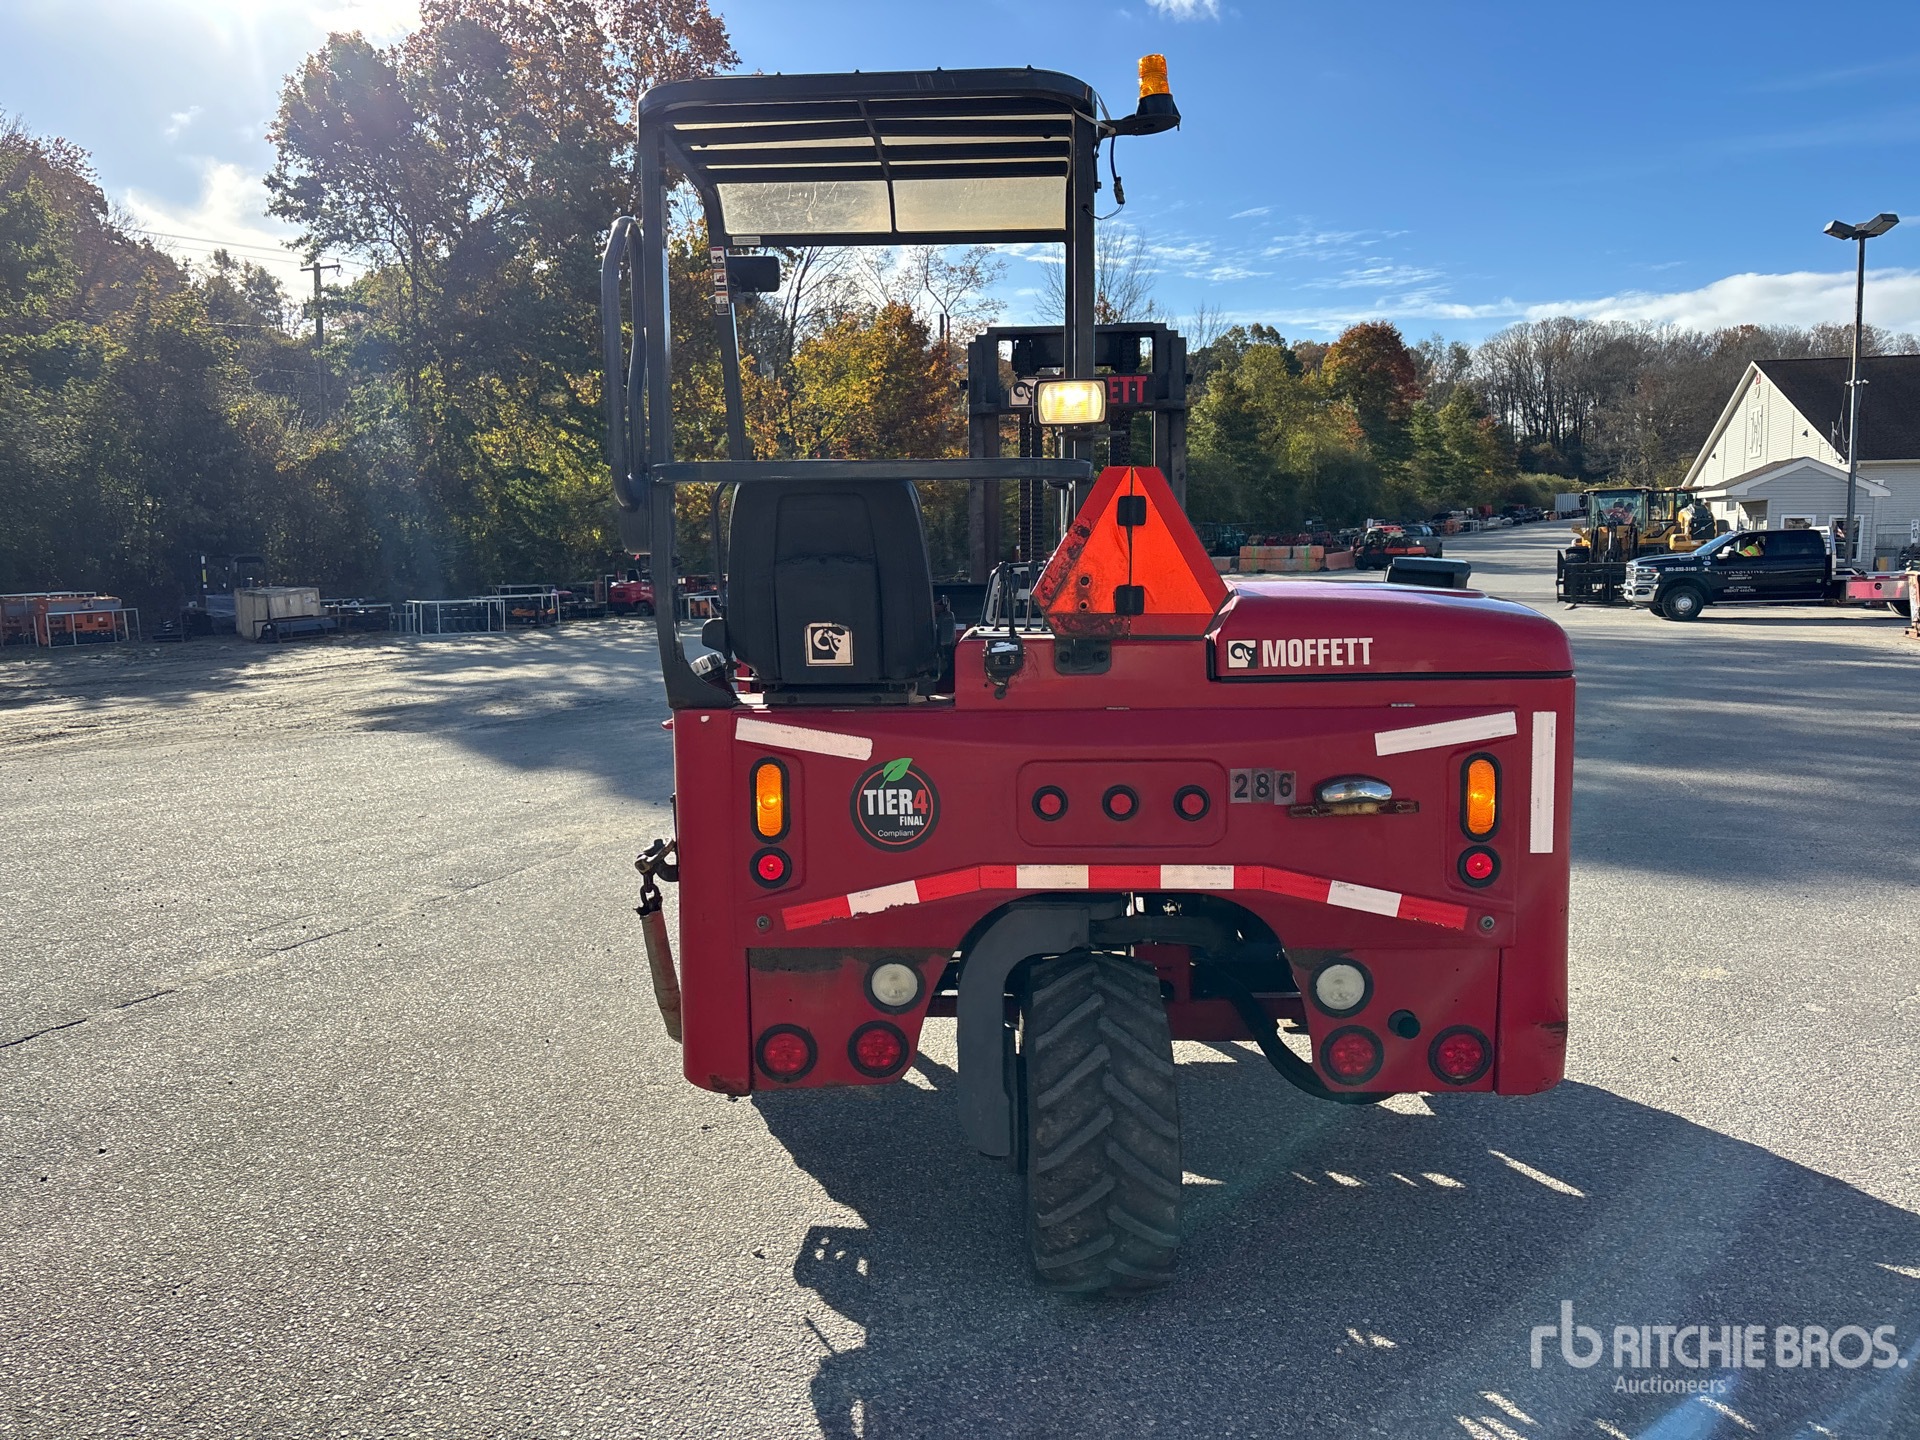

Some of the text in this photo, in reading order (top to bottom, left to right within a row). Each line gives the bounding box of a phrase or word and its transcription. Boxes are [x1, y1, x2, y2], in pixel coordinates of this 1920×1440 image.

[1262, 637, 1373, 668] MOFFETT
[1234, 773, 1292, 798] 286
[899, 815, 924, 826] FINAL
[877, 829, 914, 838] Compliant
